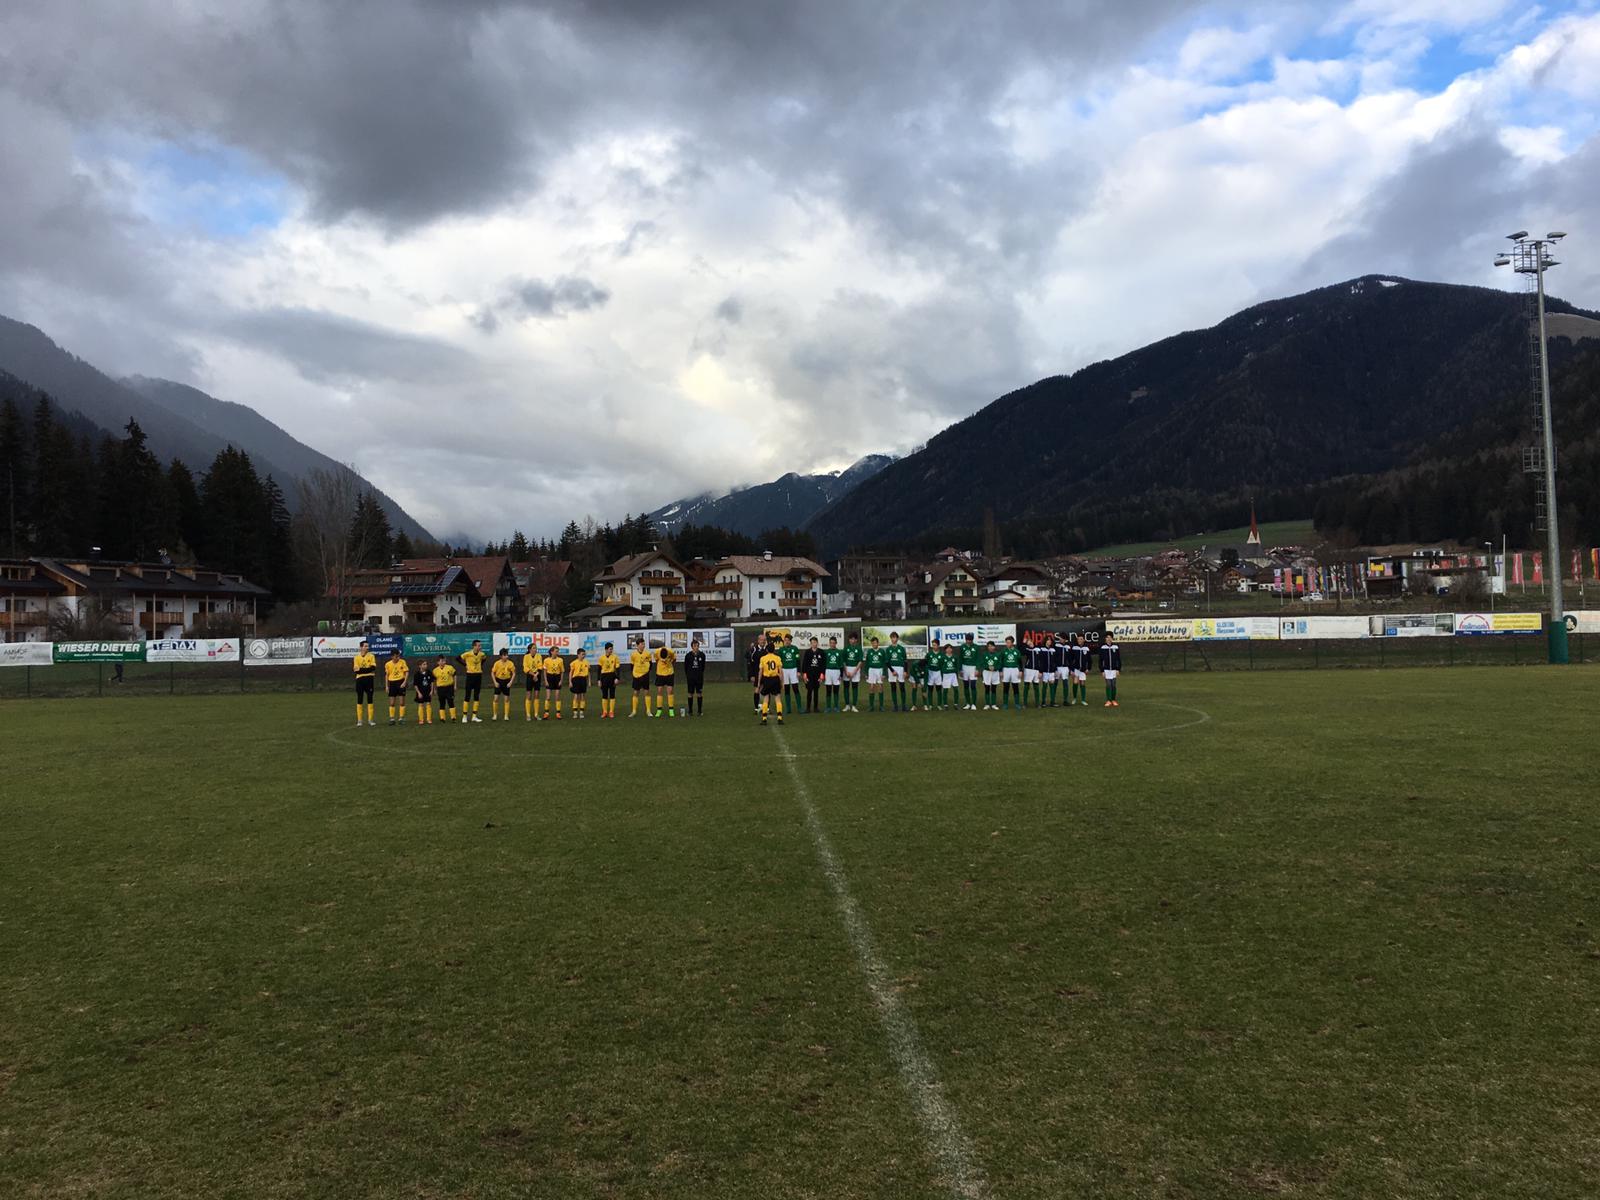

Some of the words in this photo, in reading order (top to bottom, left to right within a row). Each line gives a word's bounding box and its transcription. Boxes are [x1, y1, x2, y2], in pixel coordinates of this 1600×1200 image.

[271, 638, 305, 651] prisma
[506, 632, 570, 647] TopHaus
[57, 643, 99, 652] WIESER
[100, 643, 141, 652] DIETER
[767, 660, 776, 670] 10
